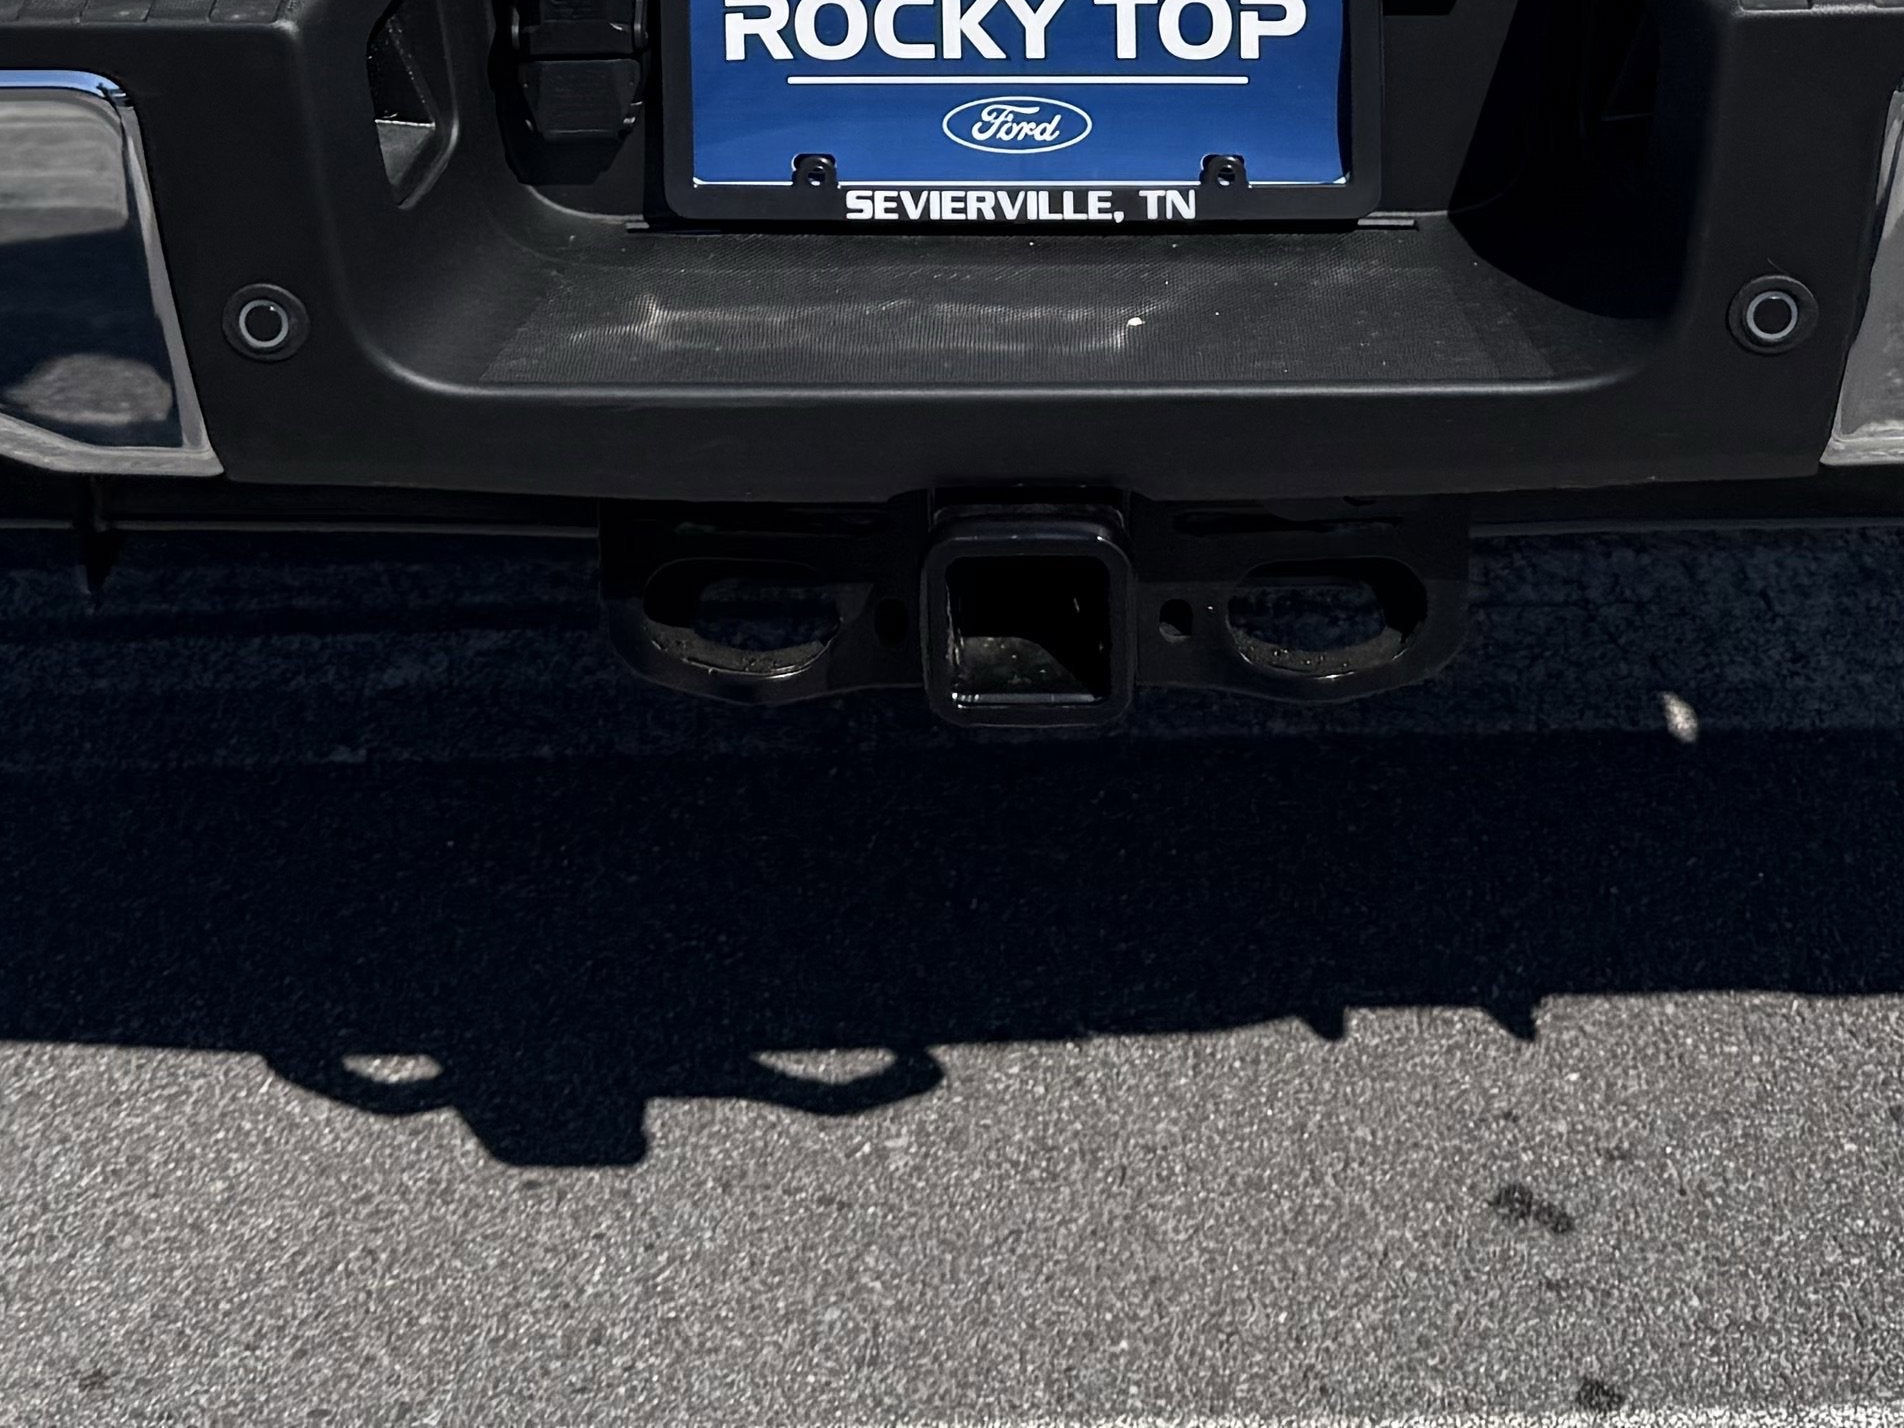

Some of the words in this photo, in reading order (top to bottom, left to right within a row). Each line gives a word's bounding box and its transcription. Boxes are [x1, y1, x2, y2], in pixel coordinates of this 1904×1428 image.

[971, 103, 1062, 142] Ford
[844, 189, 1126, 224] SEVIERVILLE,
[1138, 189, 1197, 221] TN
